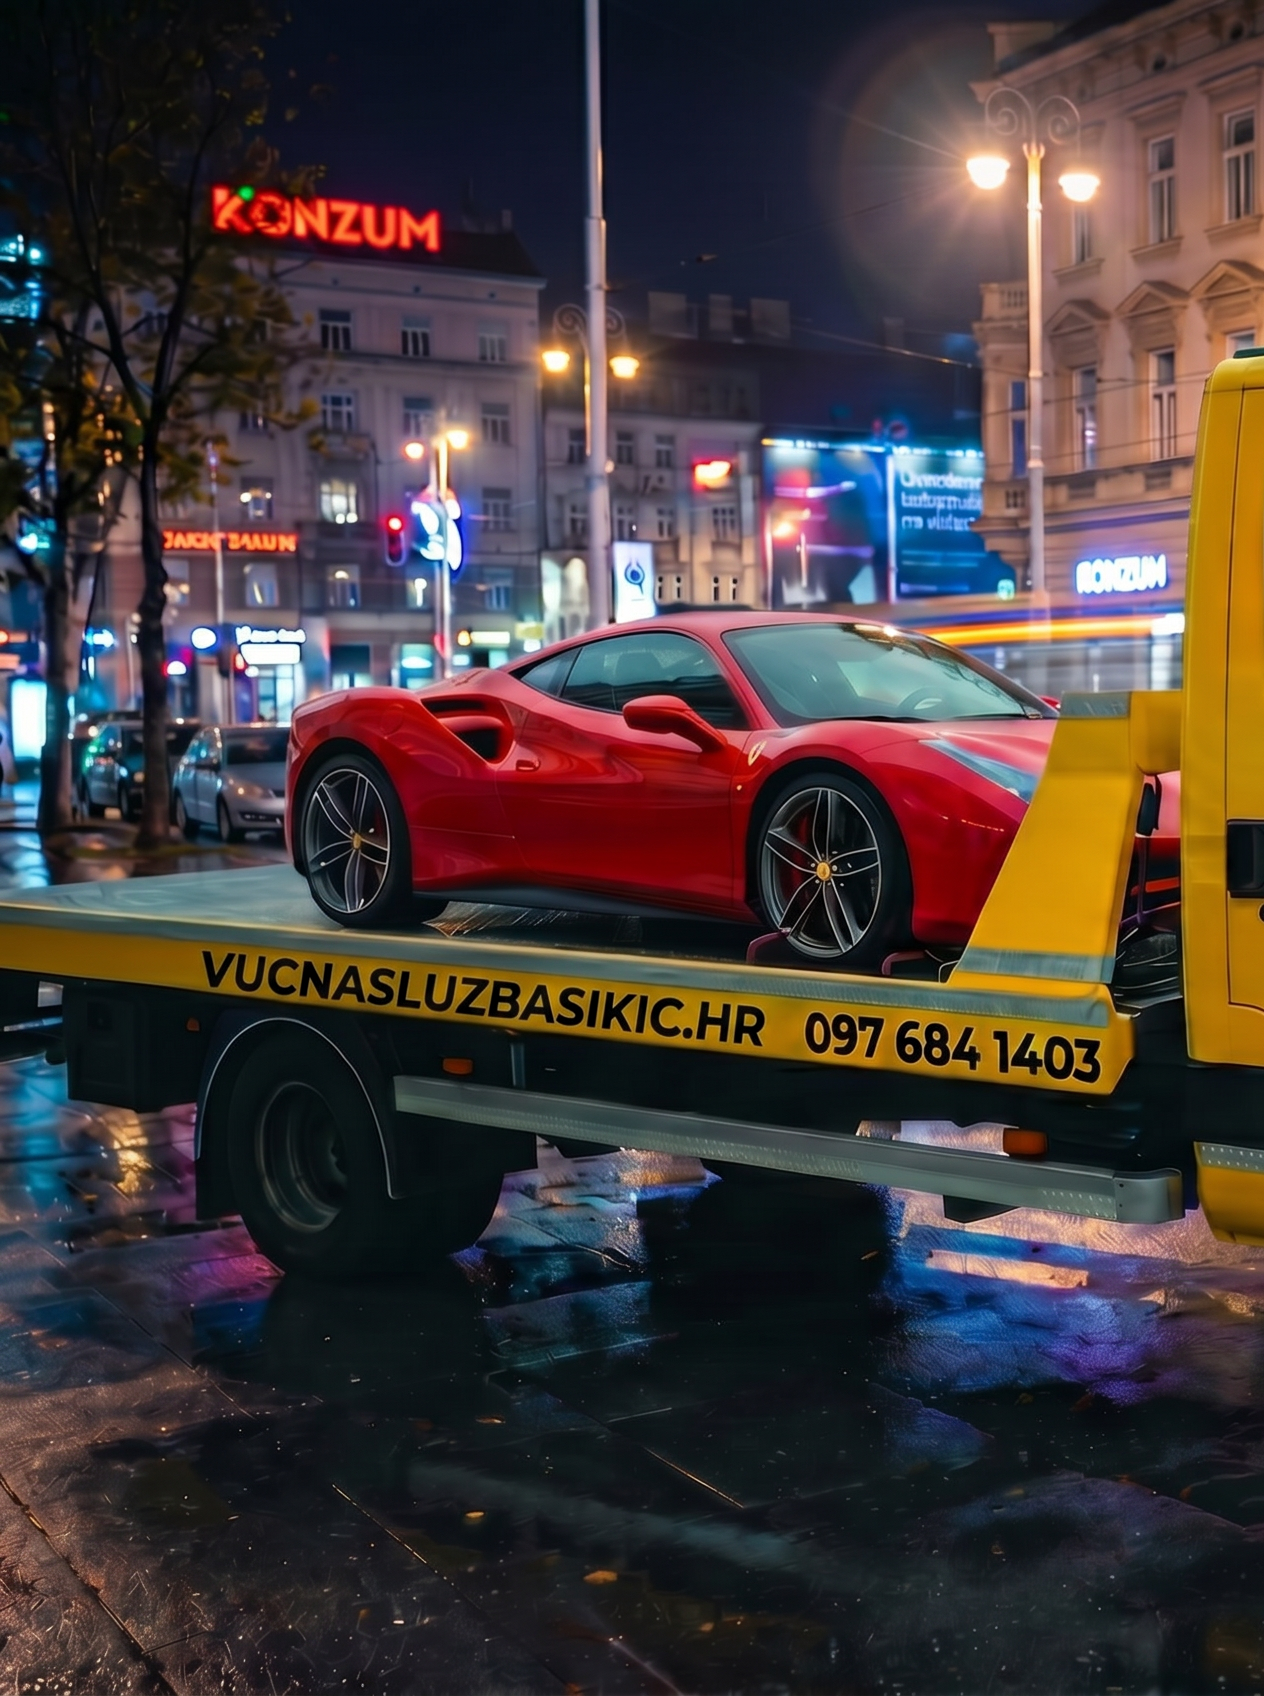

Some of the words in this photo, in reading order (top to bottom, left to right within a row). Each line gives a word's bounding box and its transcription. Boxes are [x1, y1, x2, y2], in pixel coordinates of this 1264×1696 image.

[213, 187, 440, 251] KONZUM
[202, 950, 765, 1047] VUCNASLUZBASIKIC.HR
[805, 1012, 884, 1058] 097
[896, 1021, 980, 1070] 684
[993, 1030, 1101, 1083] 1403
